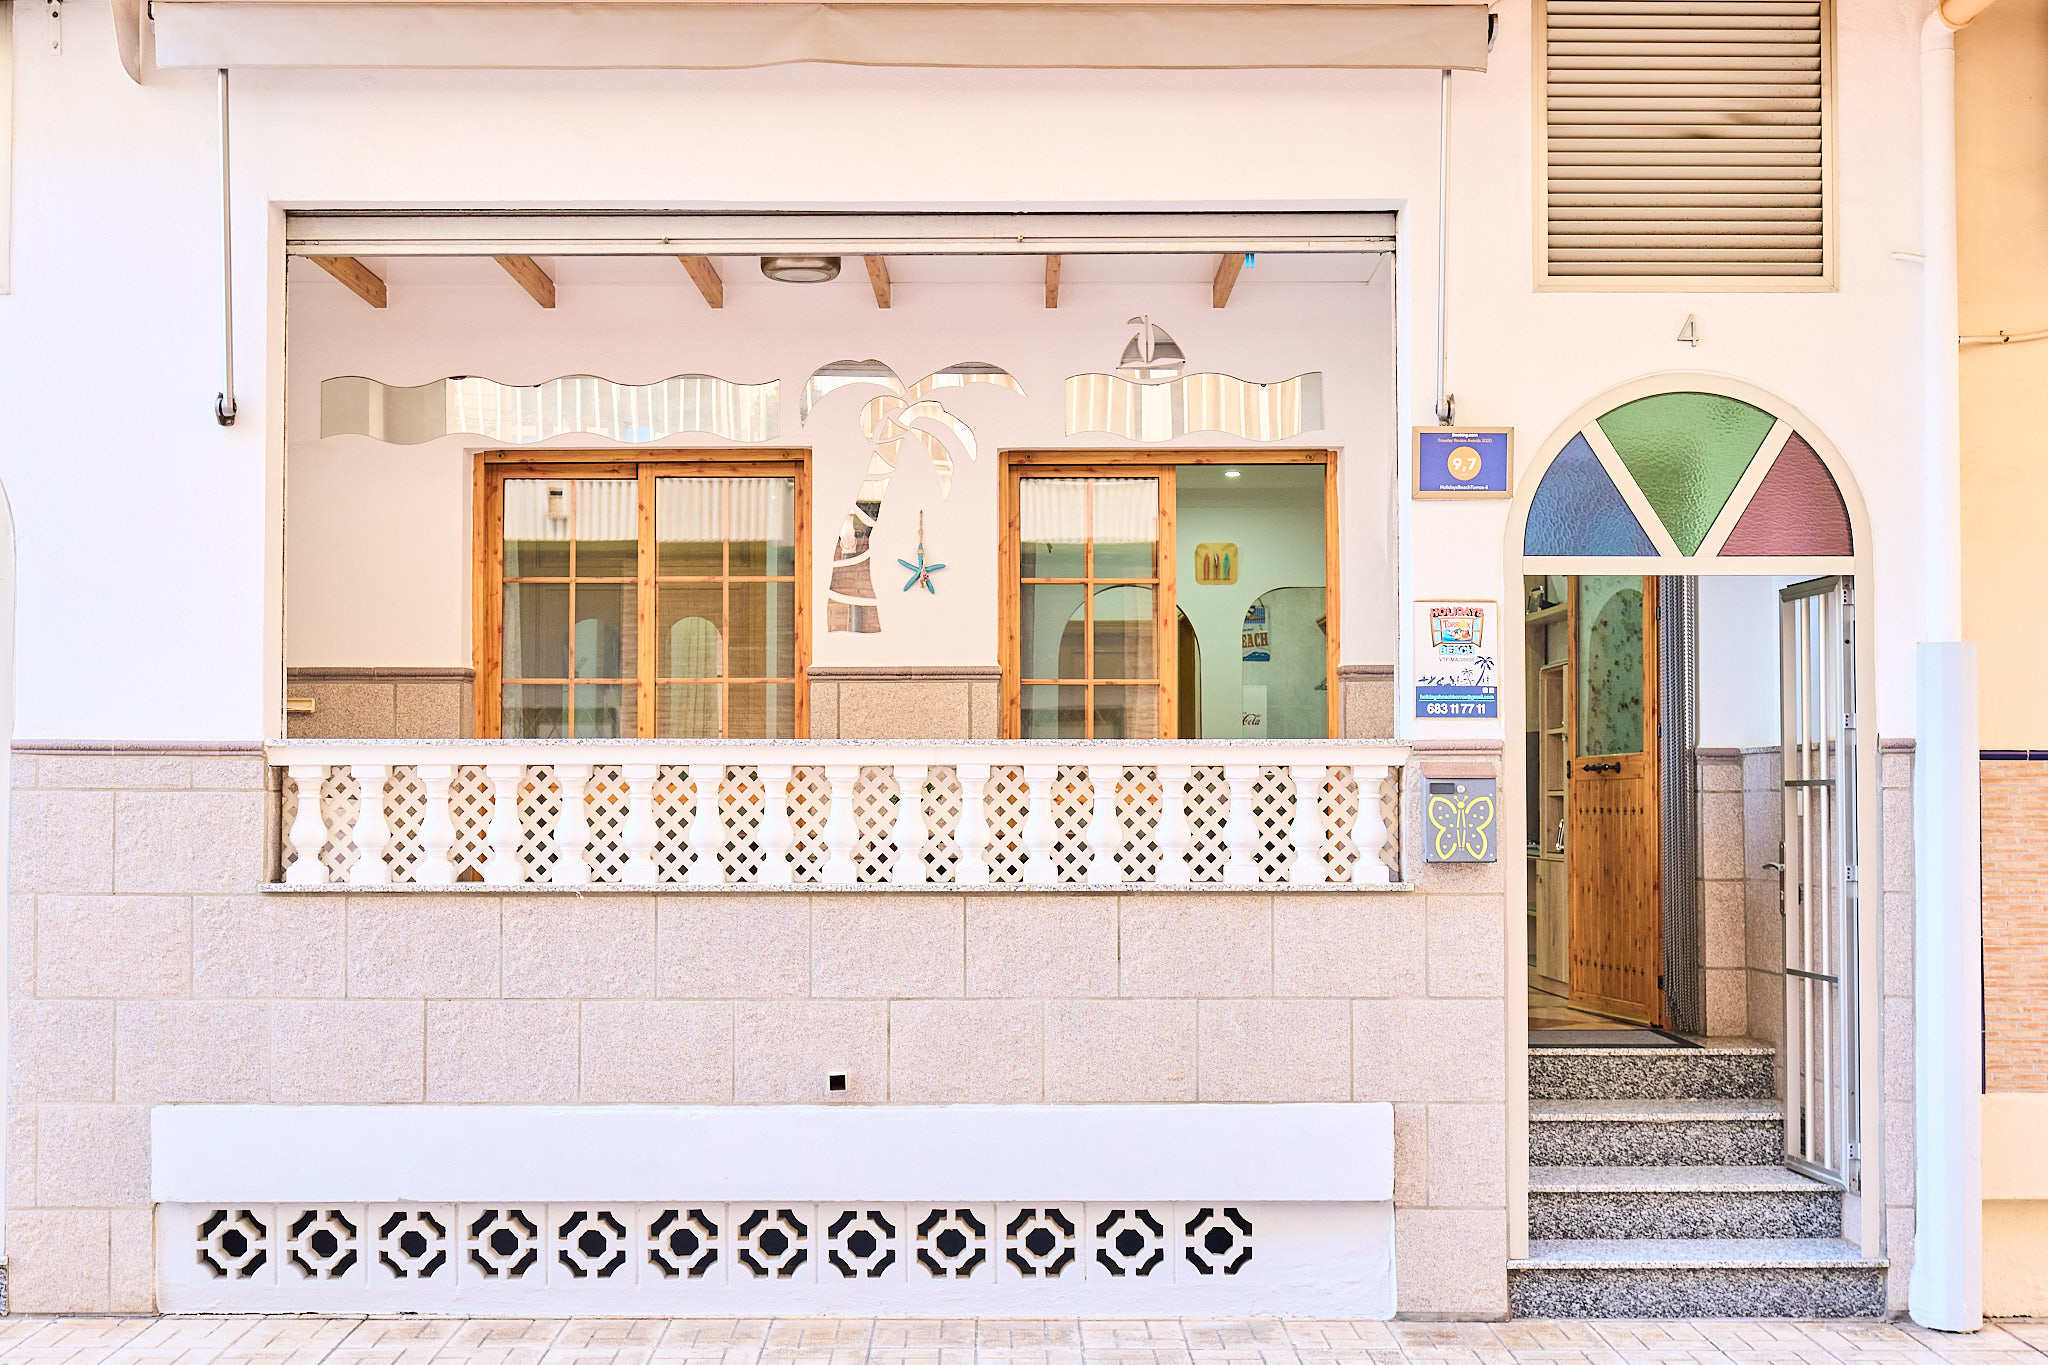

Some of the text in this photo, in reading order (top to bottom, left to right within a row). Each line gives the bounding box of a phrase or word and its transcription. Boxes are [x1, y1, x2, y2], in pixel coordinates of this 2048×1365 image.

[1677, 313, 1699, 348] 4
[1453, 457, 1477, 472] 9,7
[1430, 607, 1484, 617] HOLIDAYS
[1439, 645, 1475, 655] BEACH
[1427, 703, 1486, 715] 683 11 77 11
